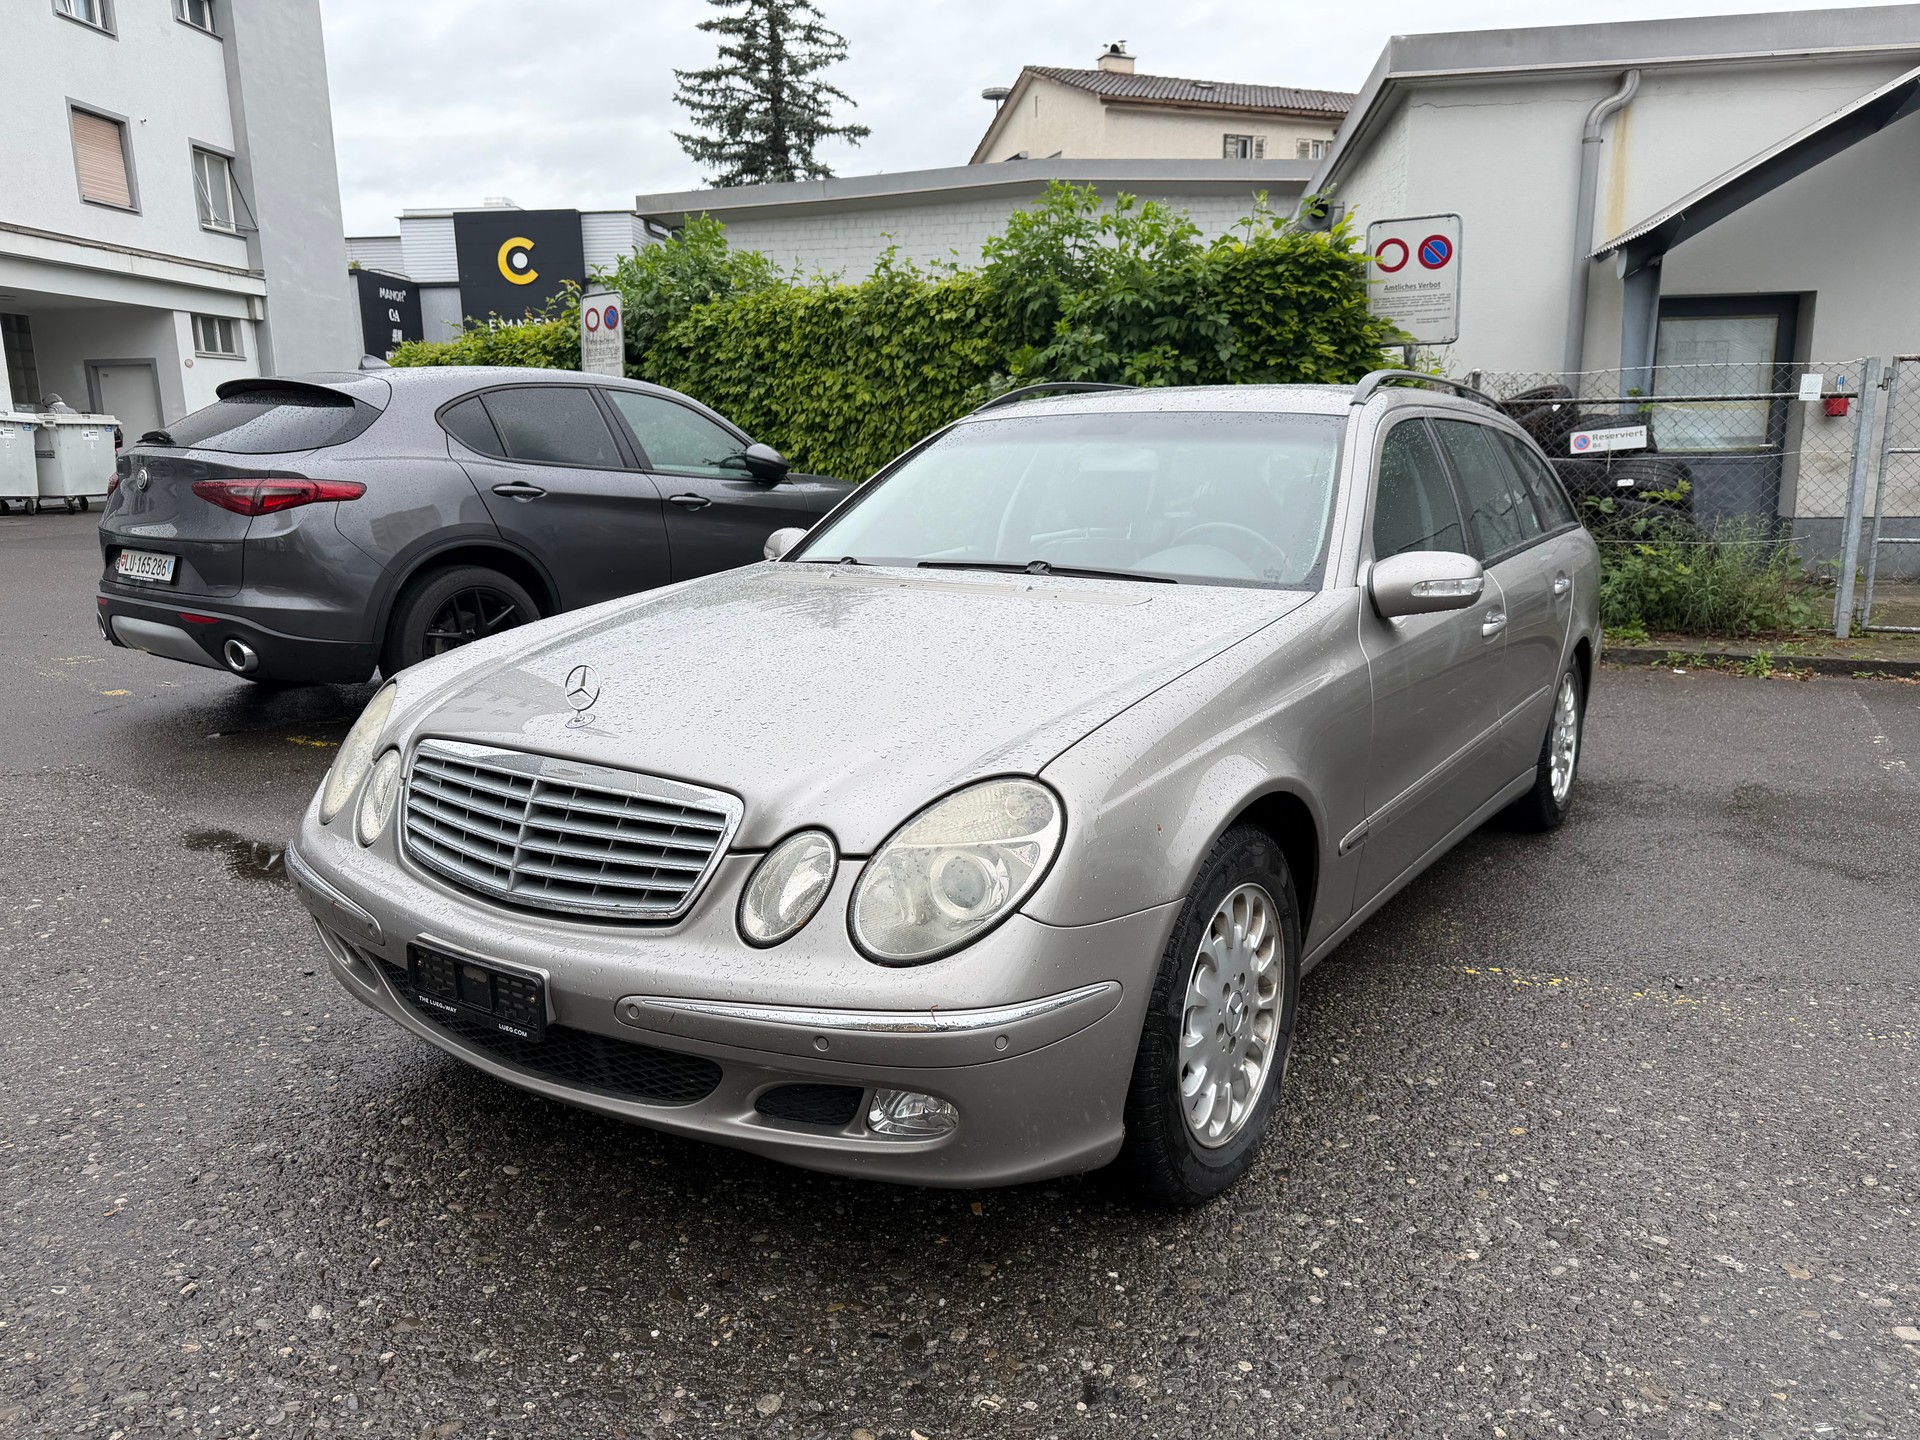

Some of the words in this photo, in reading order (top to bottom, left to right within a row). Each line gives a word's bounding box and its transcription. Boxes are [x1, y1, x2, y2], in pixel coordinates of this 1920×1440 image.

[1383, 284, 1417, 292] Amtliches
[1418, 281, 1441, 290] Verbot
[1592, 429, 1644, 441] Reserviert
[418, 995, 428, 1003] THE
